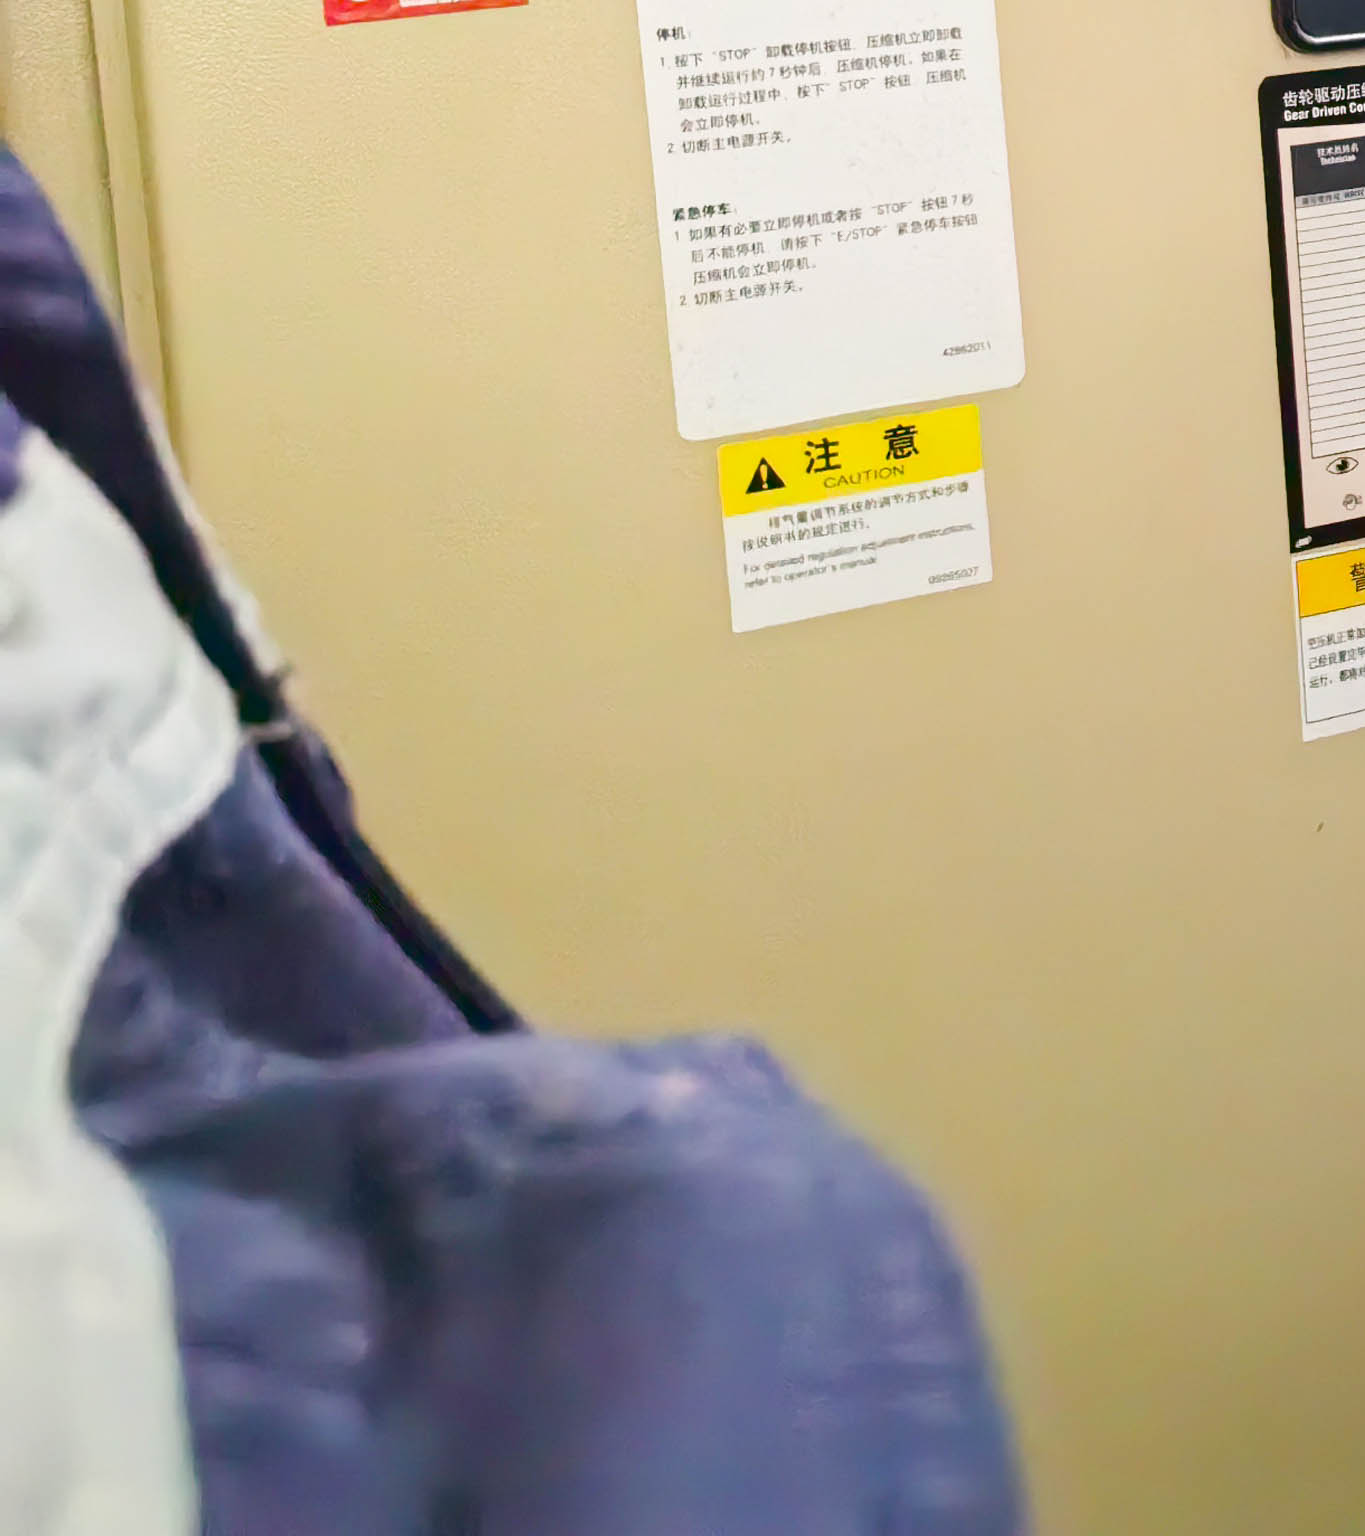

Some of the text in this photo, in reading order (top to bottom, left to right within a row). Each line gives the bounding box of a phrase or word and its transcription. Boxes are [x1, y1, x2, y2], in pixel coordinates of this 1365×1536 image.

[1284, 107, 1309, 122] Gear
[1312, 102, 1347, 119] Driven
[804, 424, 919, 474] 注意
[823, 465, 905, 489] CAUTION
